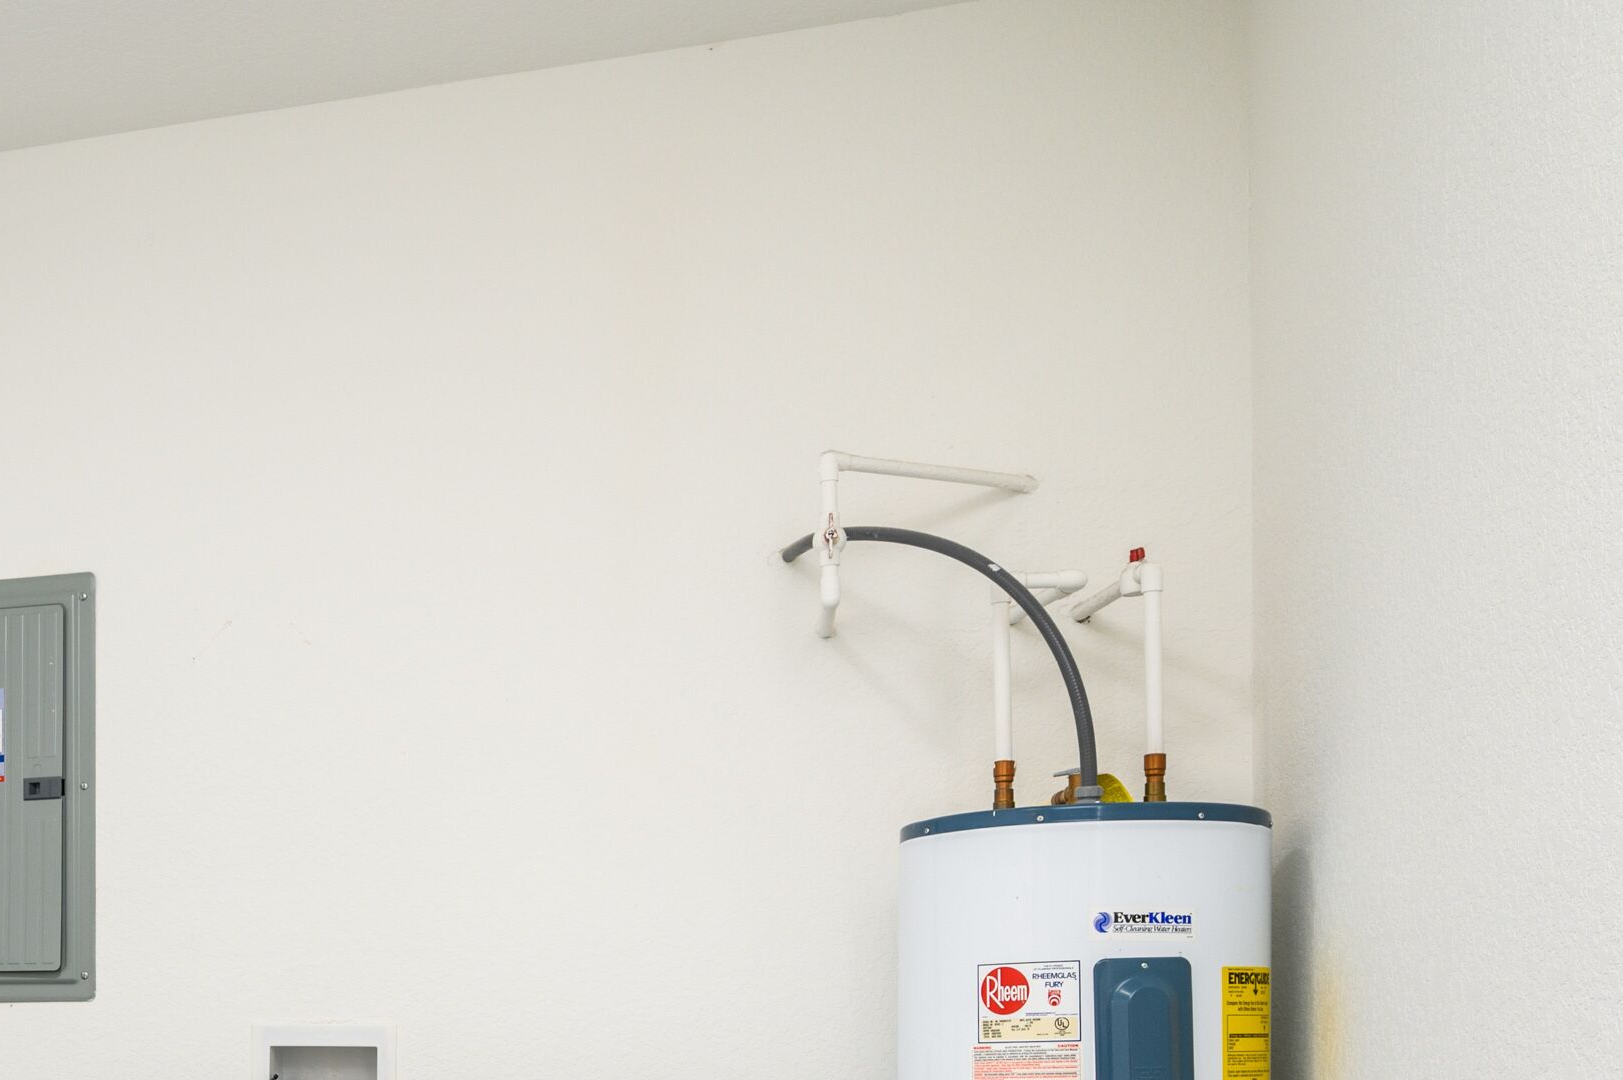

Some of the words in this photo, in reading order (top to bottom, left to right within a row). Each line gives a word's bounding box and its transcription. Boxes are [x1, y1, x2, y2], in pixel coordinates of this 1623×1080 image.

[1113, 911, 1192, 924] EverKleen
[1032, 972, 1077, 980] RHEEMGLAS
[986, 968, 1027, 1009] Rheem
